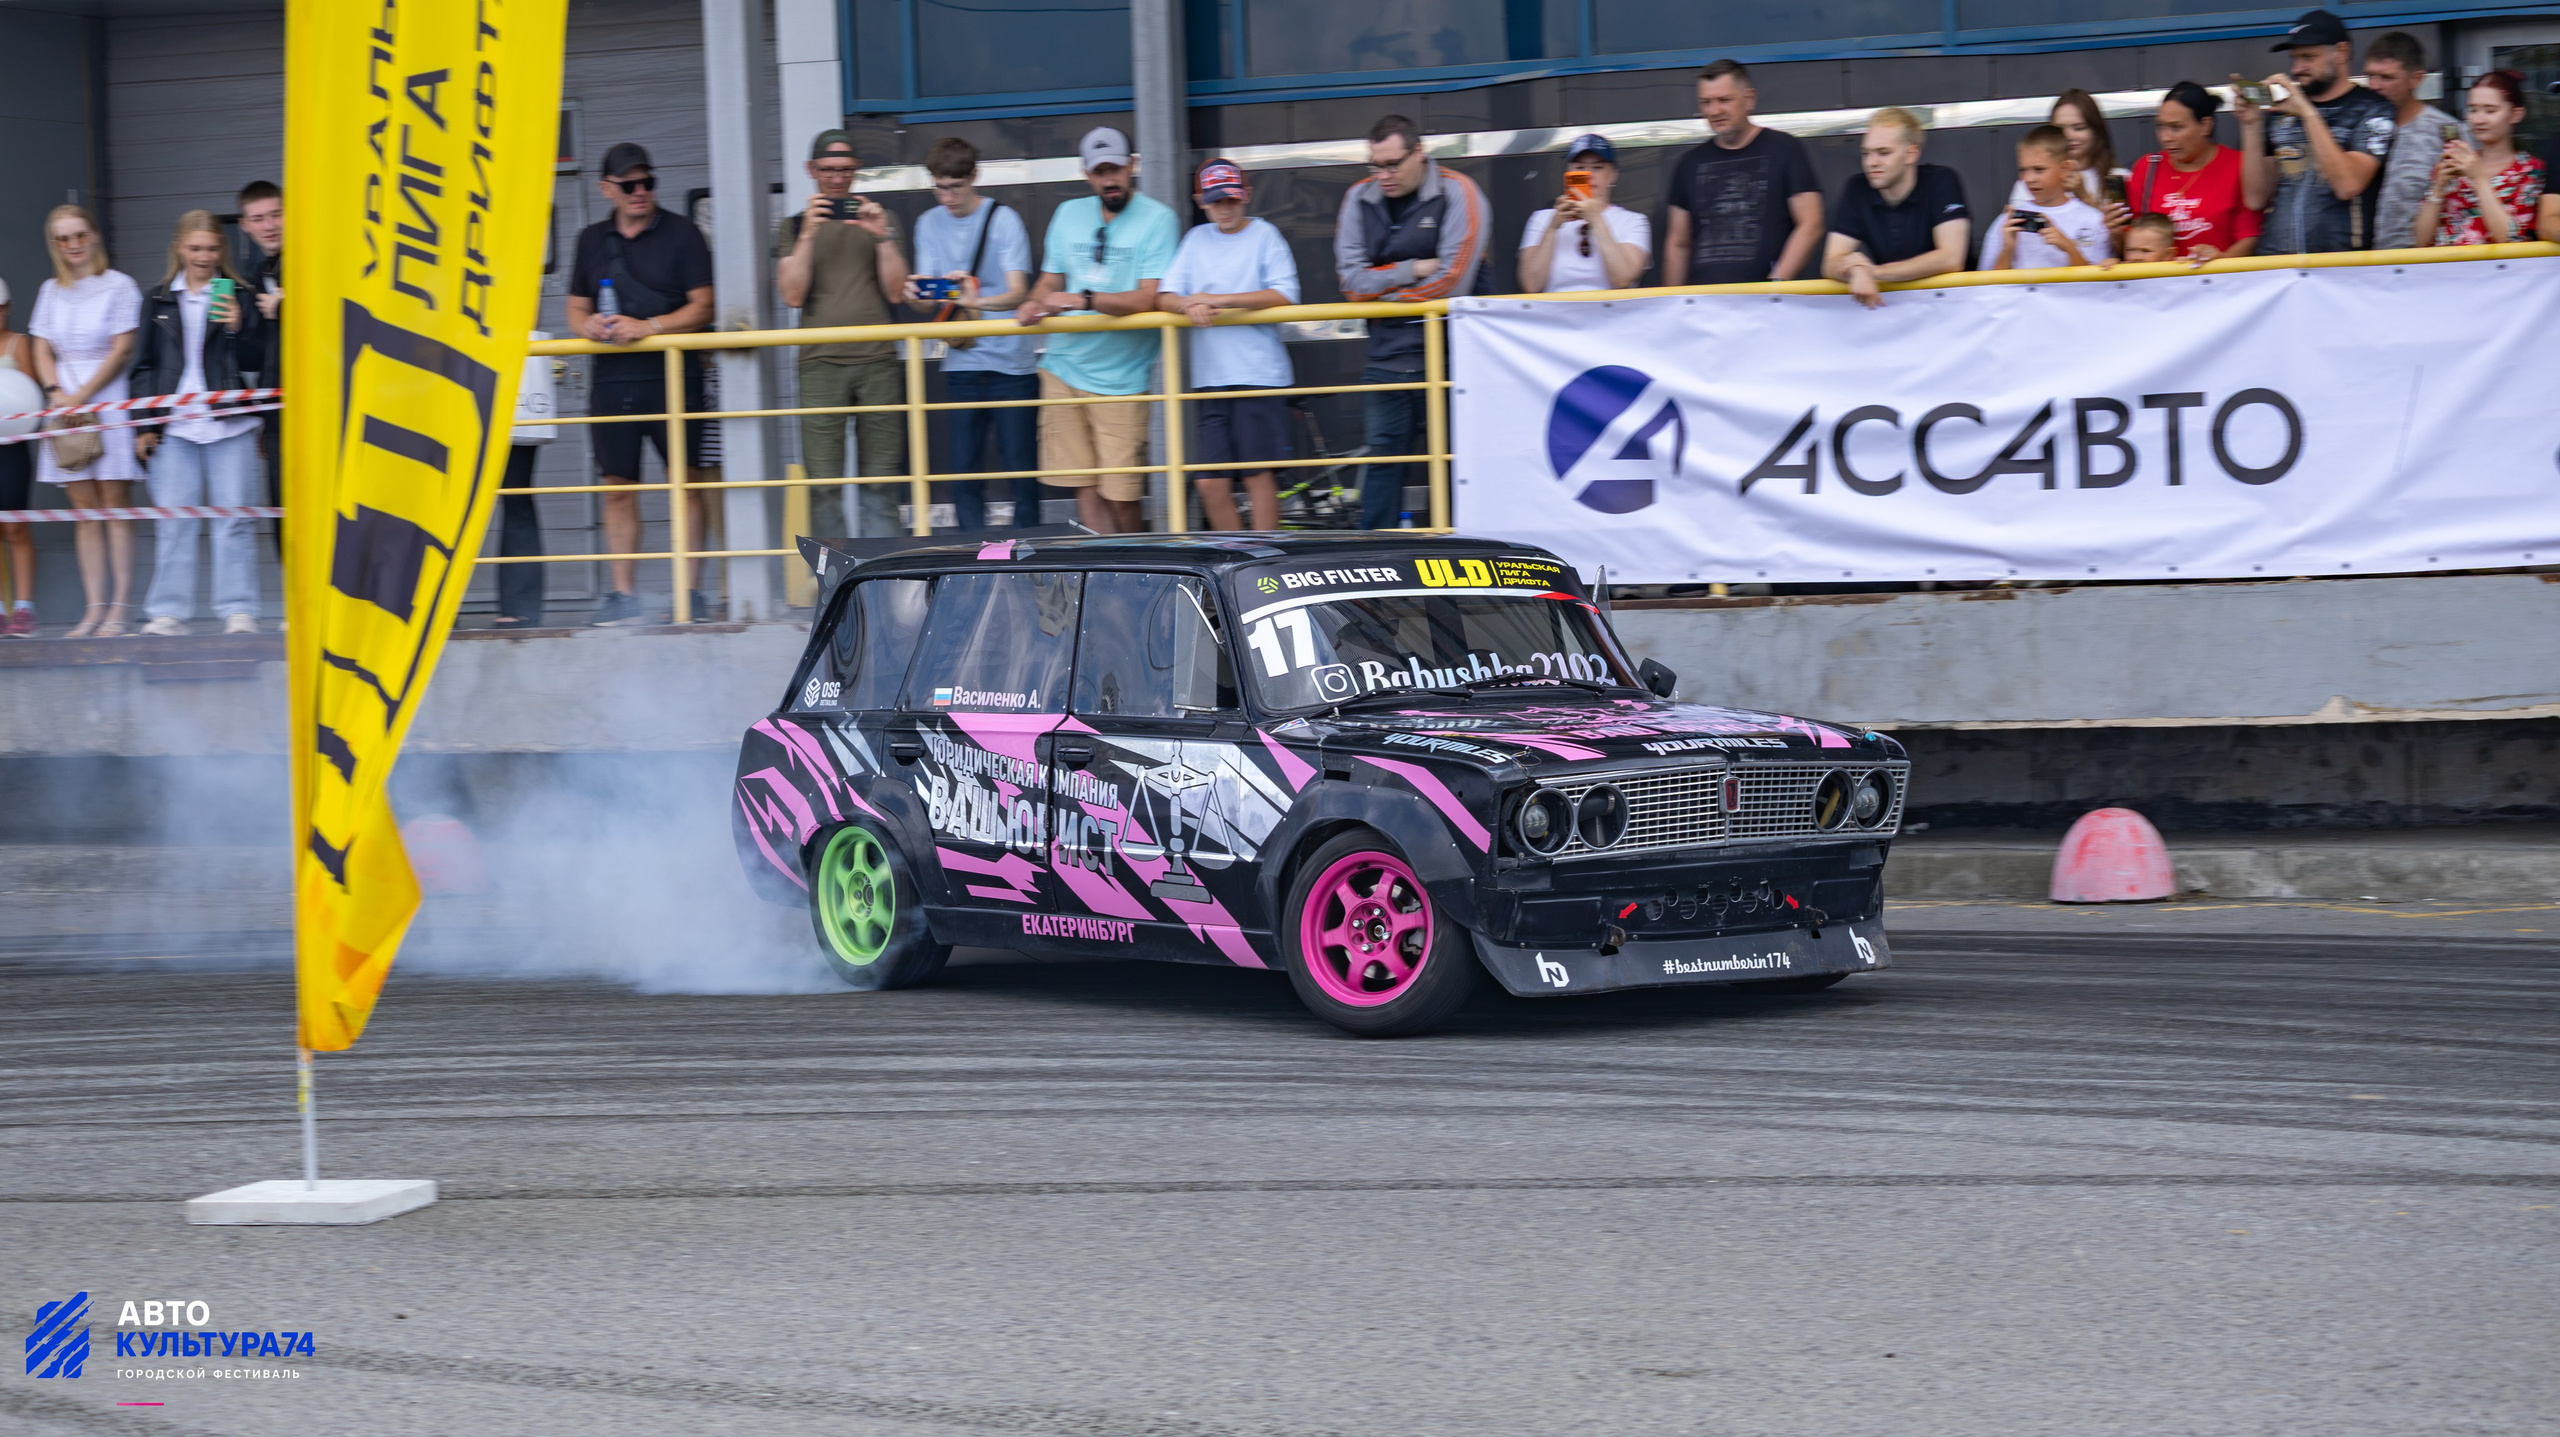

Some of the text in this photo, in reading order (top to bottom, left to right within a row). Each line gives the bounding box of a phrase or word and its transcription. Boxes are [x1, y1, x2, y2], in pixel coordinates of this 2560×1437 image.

[460, 0, 502, 337] ДРИФТ
[393, 67, 450, 311] ЛИГА
[1281, 566, 1402, 589] BIG FILTER
[1415, 559, 1493, 588] ULD
[1495, 561, 1561, 574] УРАЛЬСКАЯ
[1500, 569, 1531, 577] ЛИГА
[1503, 577, 1551, 587] ДРИФТА
[1247, 608, 1316, 678] 17
[821, 681, 841, 698] OSG
[952, 686, 1026, 708] Василенко
[1382, 732, 1512, 764] YOURMILES
[1641, 737, 1789, 756] YOURMILES
[932, 737, 1036, 789] ЮРИДИЧЕСКАЯ
[928, 775, 1119, 877] ВАШ ЮРИСТ
[1021, 914, 1136, 944] ЕКАТЕРИНБУРГ
[1662, 952, 1792, 976] #bestnumberin174
